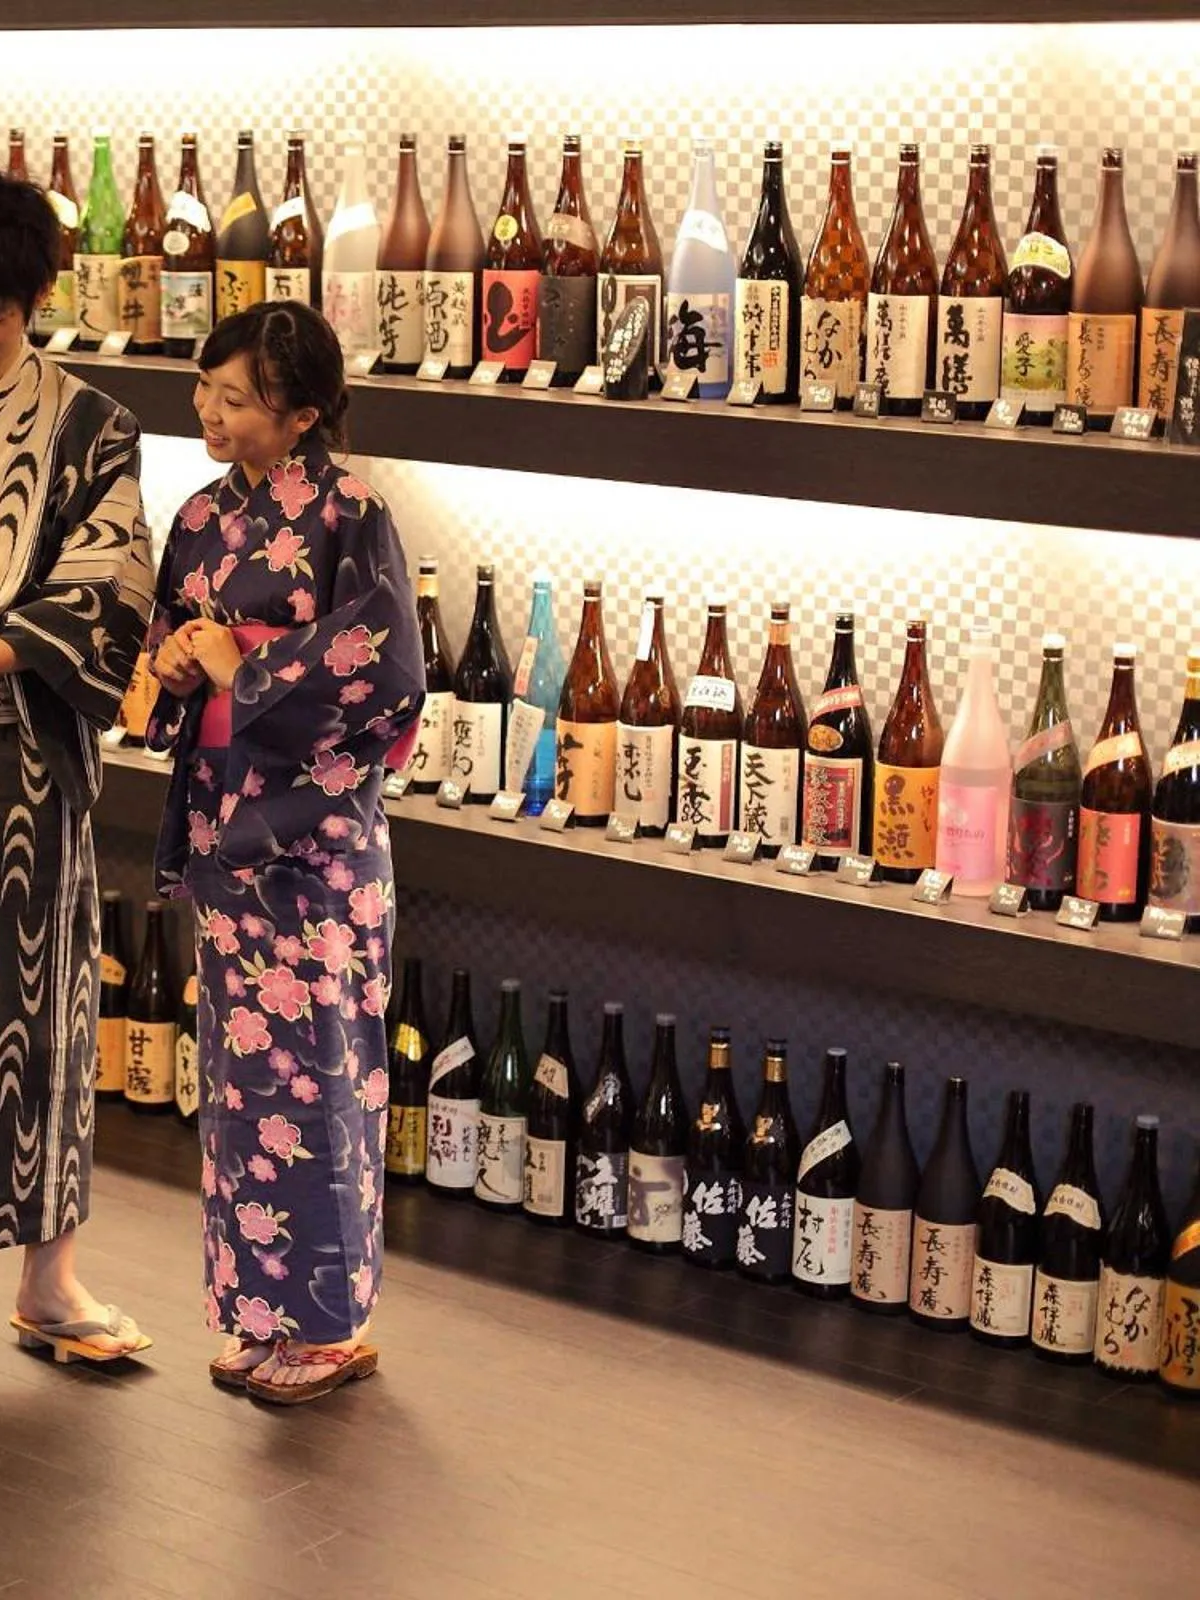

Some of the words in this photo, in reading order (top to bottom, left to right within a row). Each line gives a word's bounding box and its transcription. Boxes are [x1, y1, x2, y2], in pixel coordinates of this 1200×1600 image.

[669, 299, 724, 373] 海
[682, 1181, 725, 1252] 佐藤
[736, 1194, 777, 1266] 佐藤
[796, 1198, 825, 1277] 村尾
